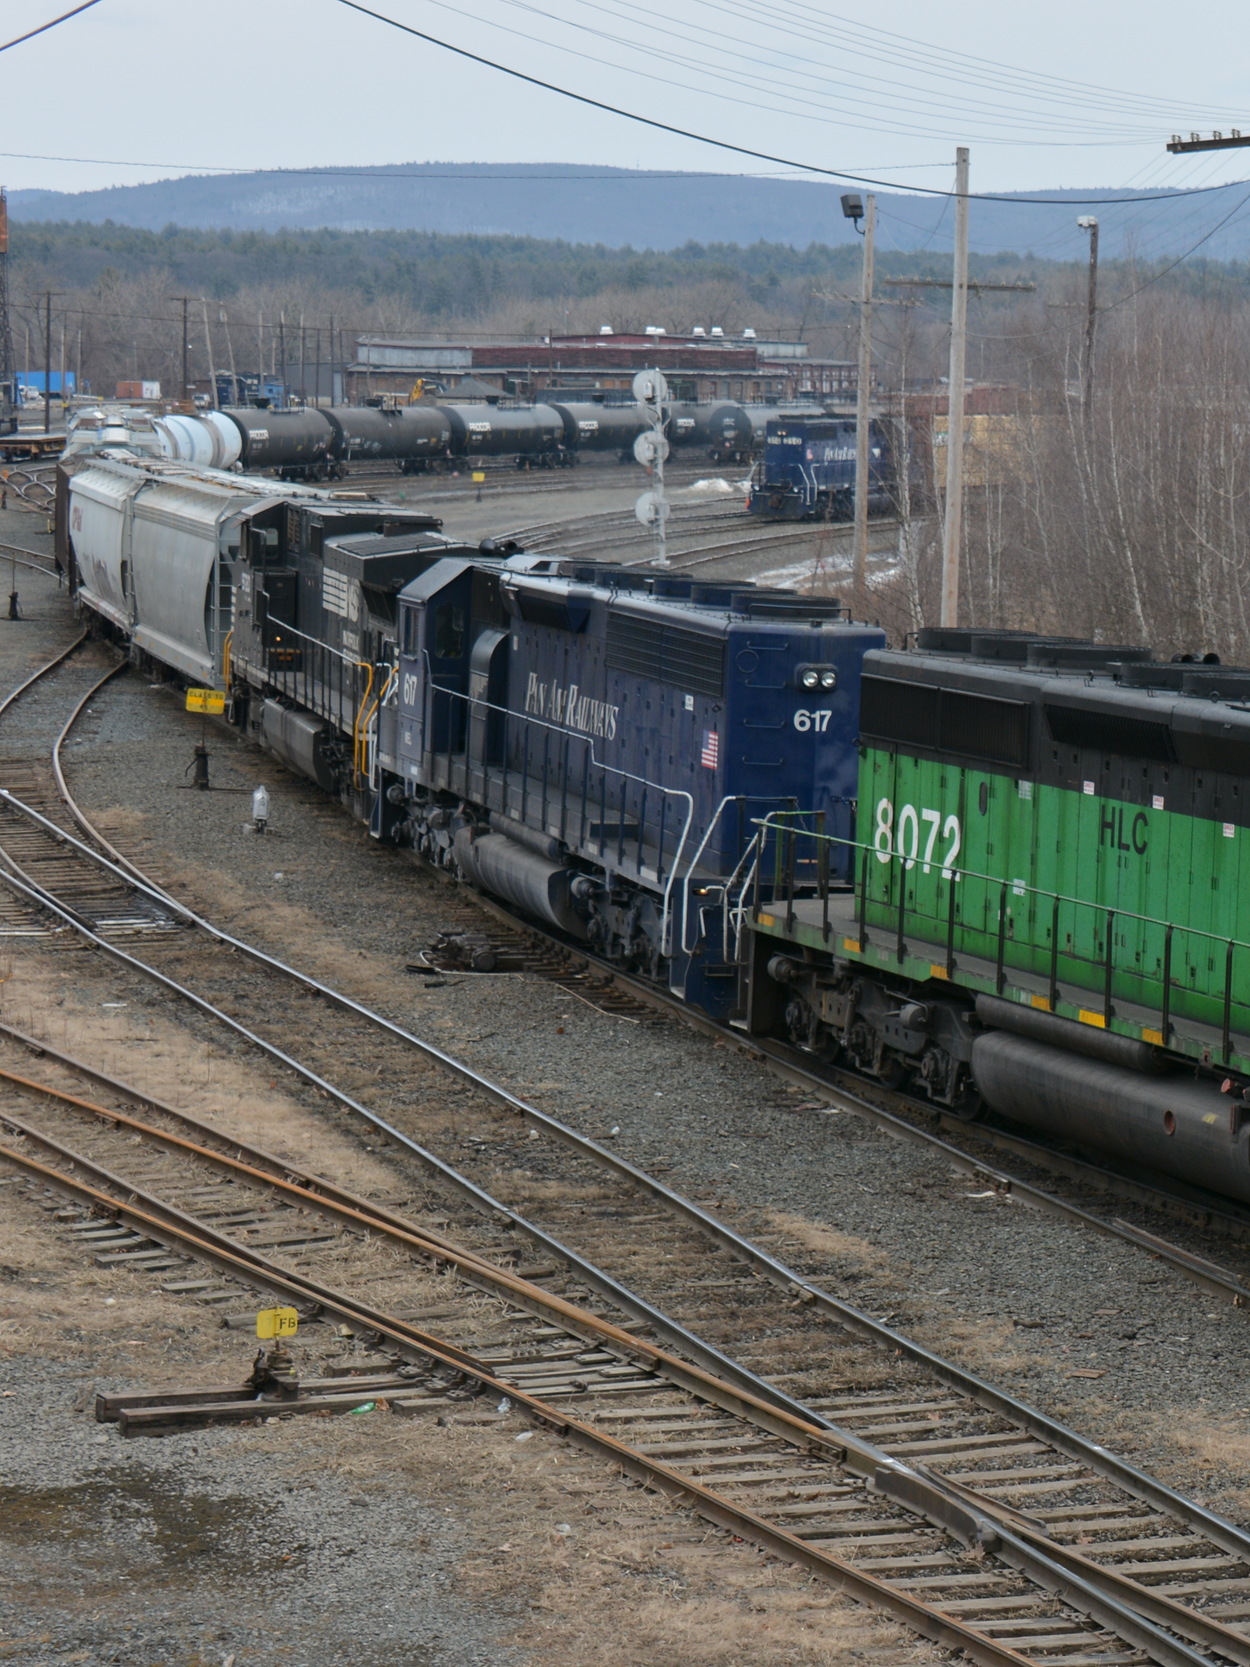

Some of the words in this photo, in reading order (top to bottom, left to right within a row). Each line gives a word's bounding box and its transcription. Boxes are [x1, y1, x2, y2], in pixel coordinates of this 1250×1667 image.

[403, 672, 418, 706] 617
[525, 672, 547, 715] PAN
[546, 679, 567, 723] AM
[565, 684, 619, 740] RAILWAYS
[793, 709, 832, 732] 617
[874, 797, 961, 882] 8072
[1101, 804, 1149, 855] HLC
[279, 1317, 296, 1329] FB
